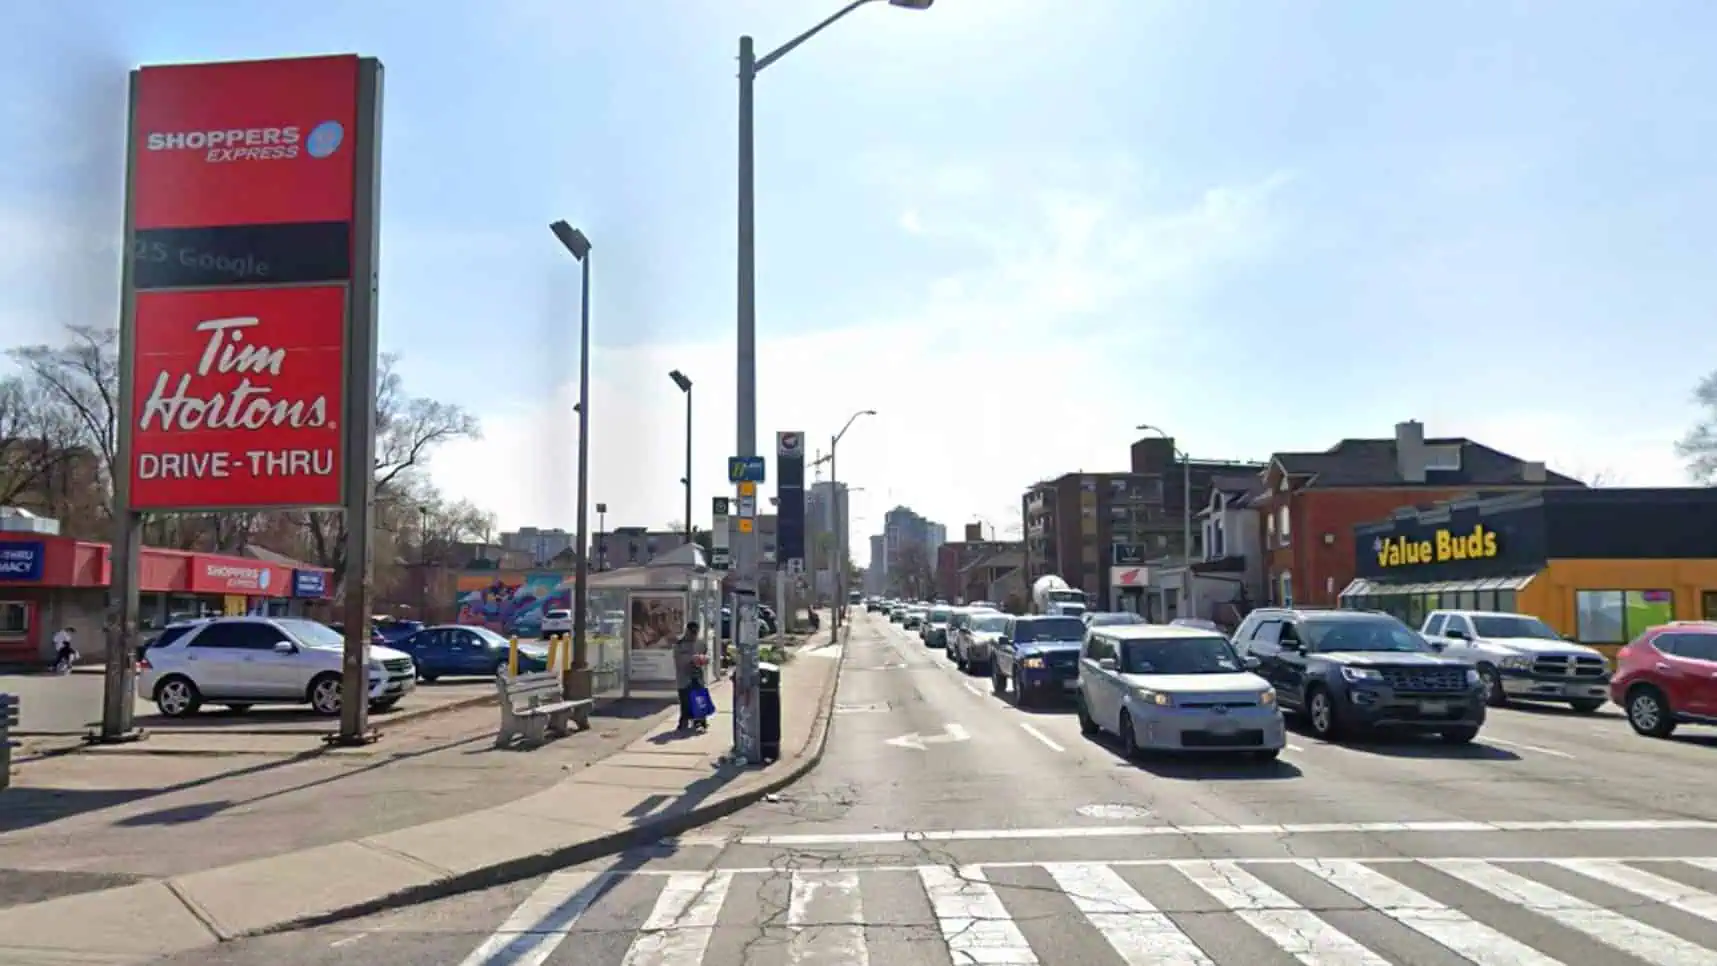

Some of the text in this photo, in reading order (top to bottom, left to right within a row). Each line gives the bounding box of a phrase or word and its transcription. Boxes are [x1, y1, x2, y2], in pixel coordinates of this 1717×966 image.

[147, 126, 300, 151] SHOPPERS
[205, 145, 299, 163] EXPRESS
[196, 316, 287, 376] Tim
[139, 370, 326, 431] Hortons
[139, 449, 333, 479] DRIVE-THRU
[1377, 523, 1498, 567] Value Buds
